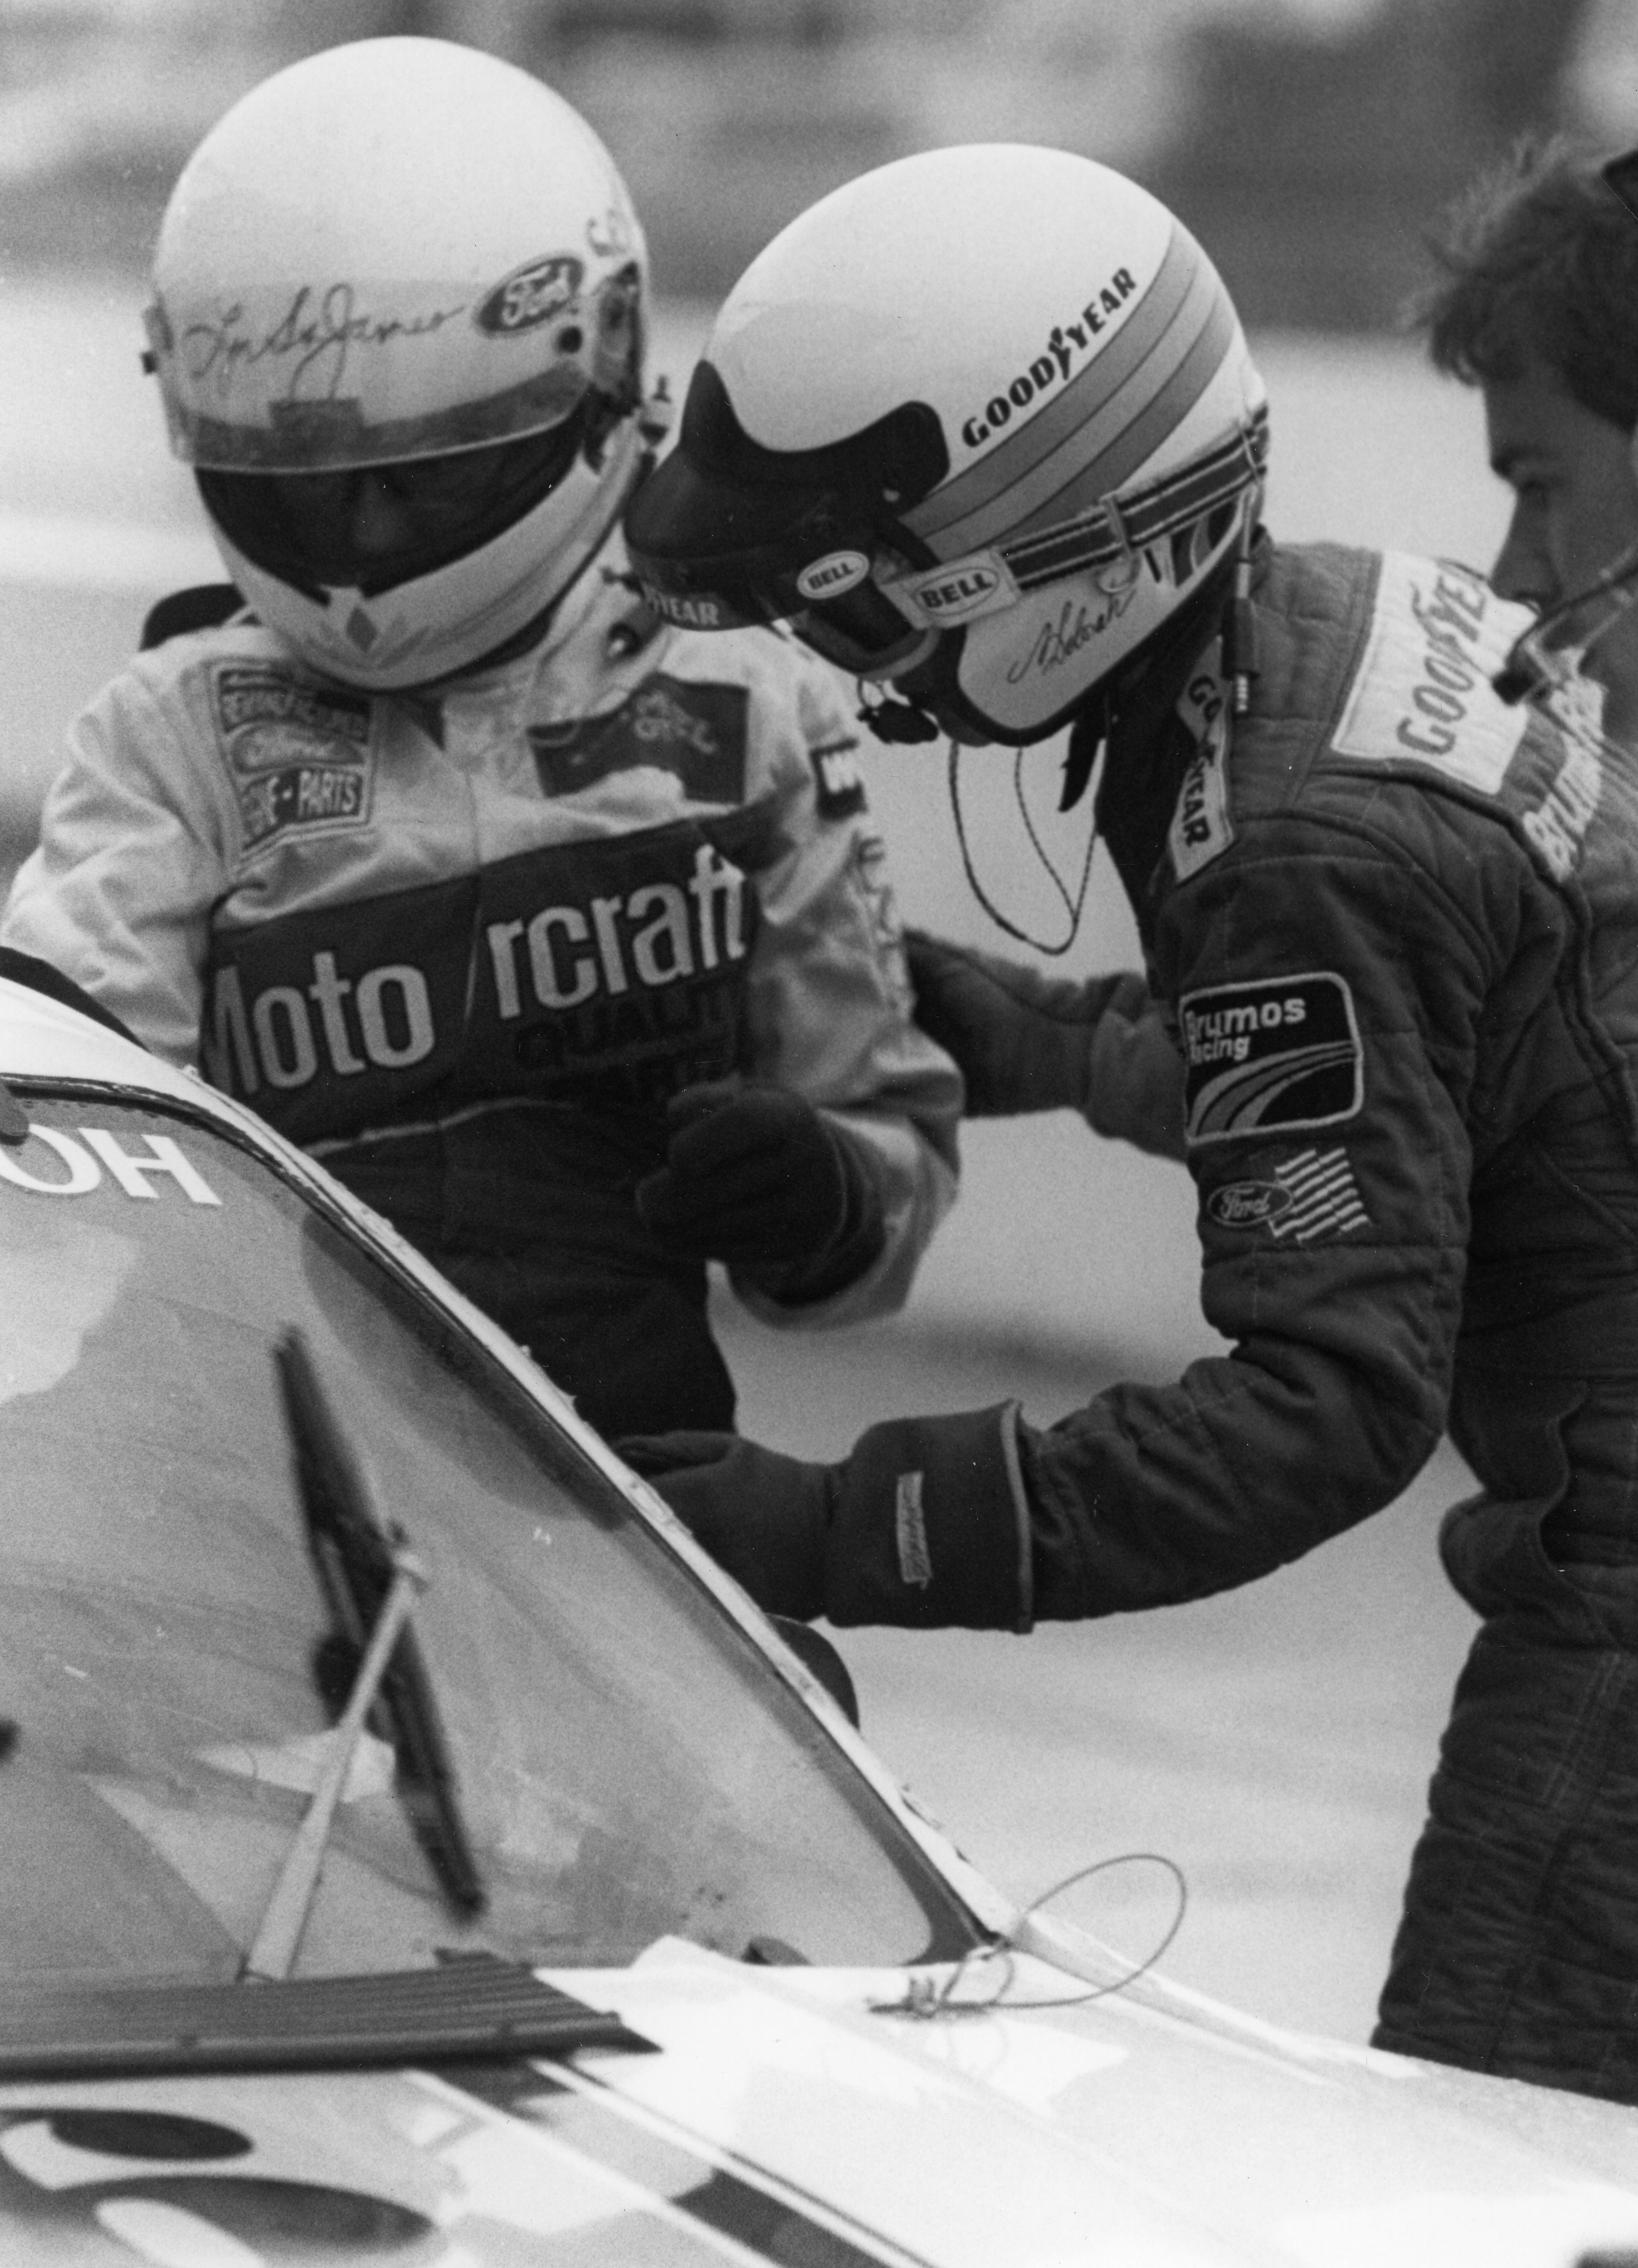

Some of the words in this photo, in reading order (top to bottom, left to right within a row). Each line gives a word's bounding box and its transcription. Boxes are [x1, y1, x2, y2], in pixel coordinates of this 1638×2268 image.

[961, 267, 1137, 448] GOODYEAR
[807, 562, 855, 590] BELL
[917, 569, 995, 613] BELL
[1219, 1188, 1271, 1219] Ford
